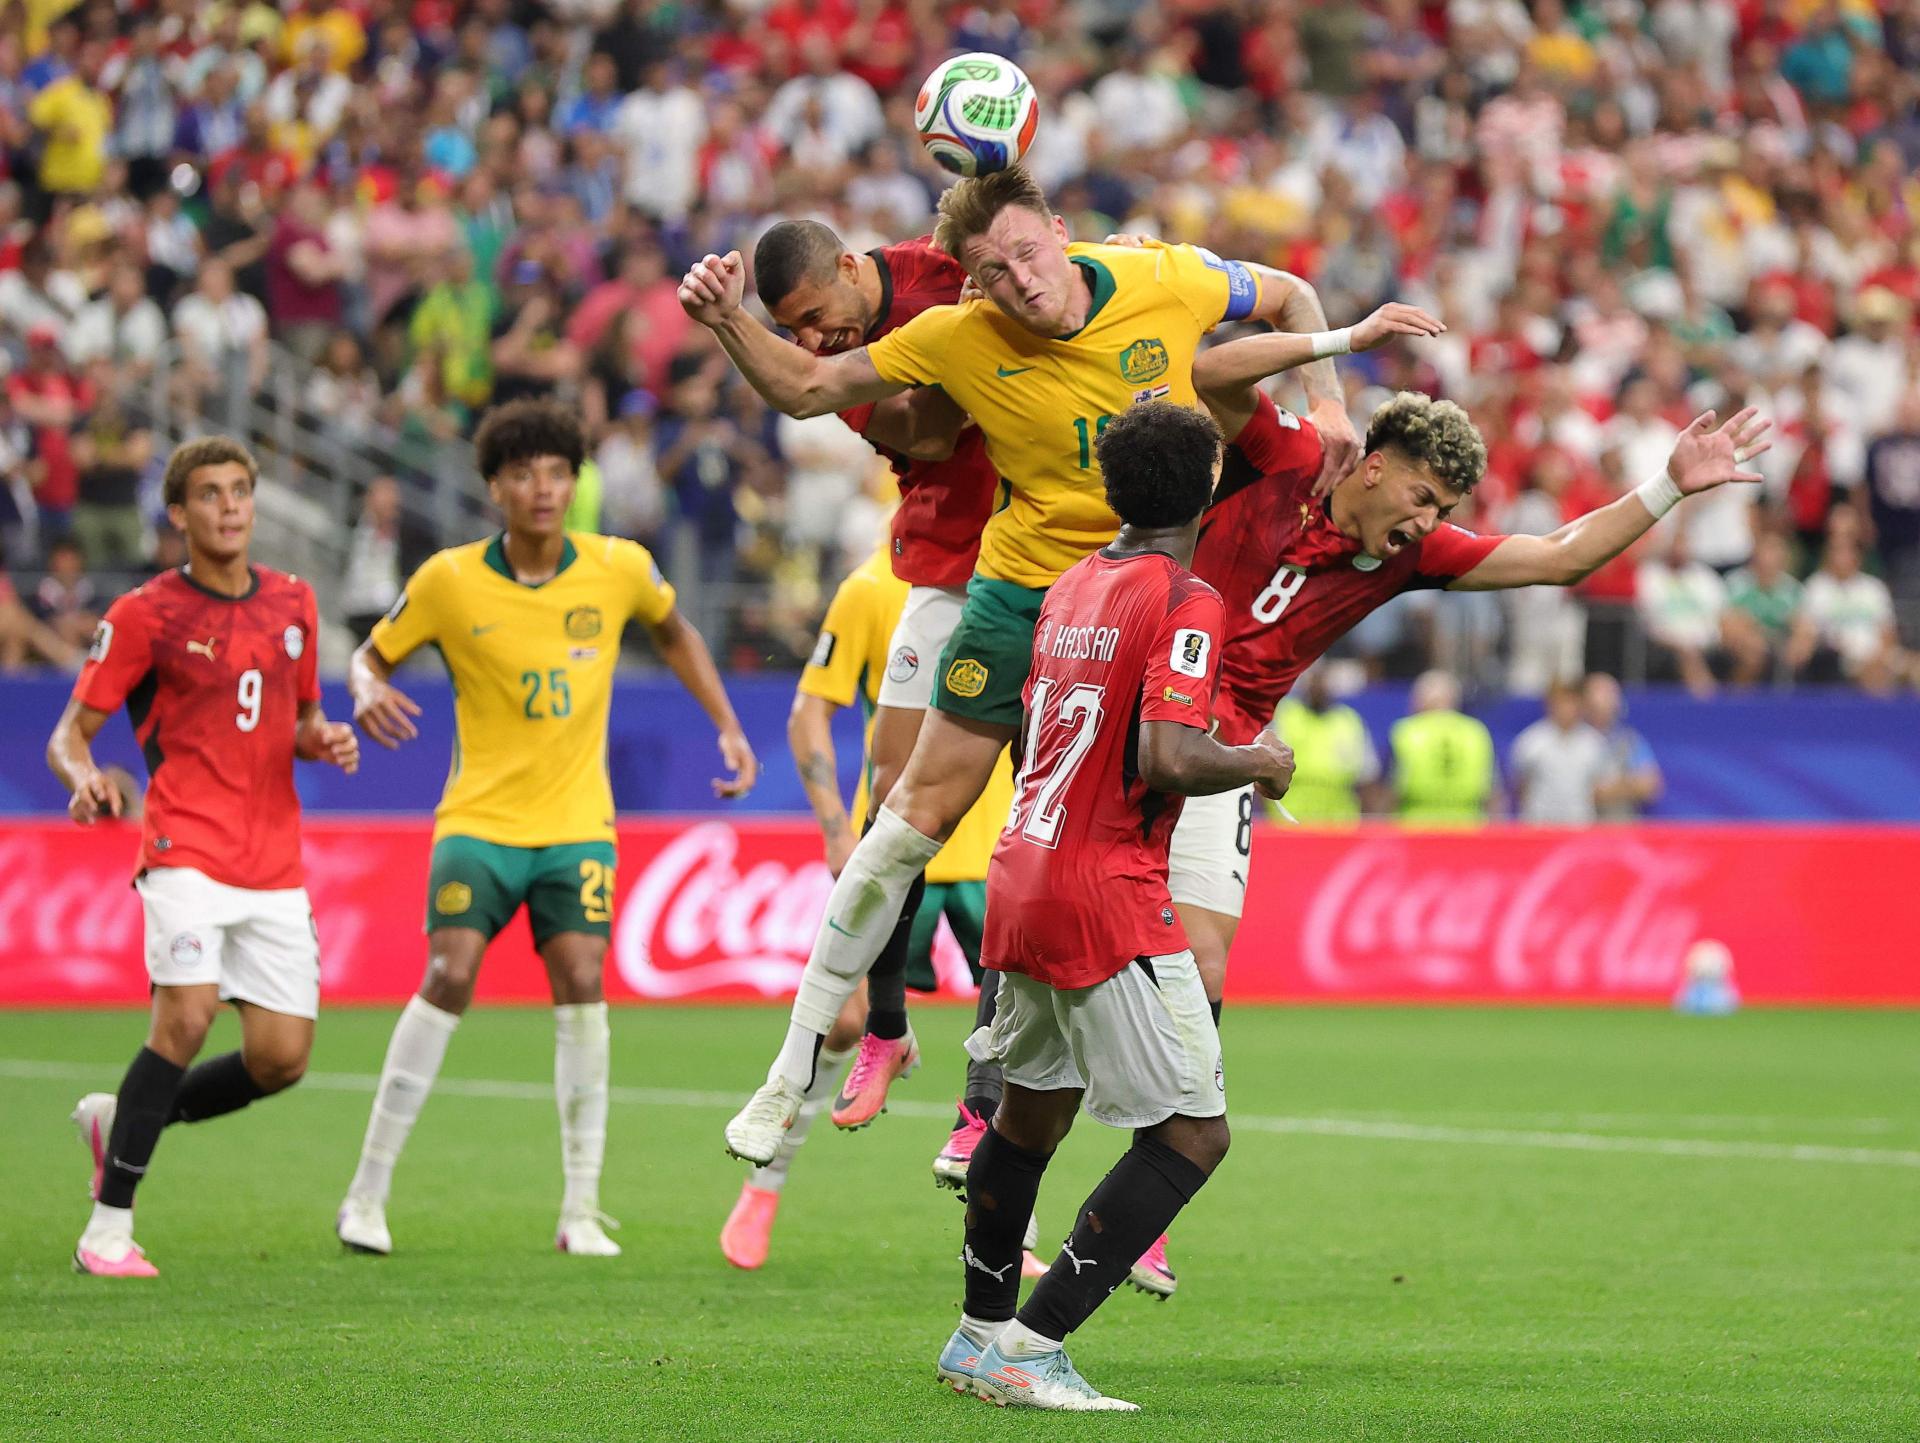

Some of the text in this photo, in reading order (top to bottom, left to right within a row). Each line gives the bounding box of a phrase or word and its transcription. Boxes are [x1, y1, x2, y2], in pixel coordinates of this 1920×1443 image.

[1251, 564, 1307, 624] 8
[1051, 624, 1120, 662] HASSAN
[236, 669, 263, 732] 9
[521, 669, 571, 719] 25
[1004, 676, 1106, 850] 12
[1236, 793, 1252, 856] 8
